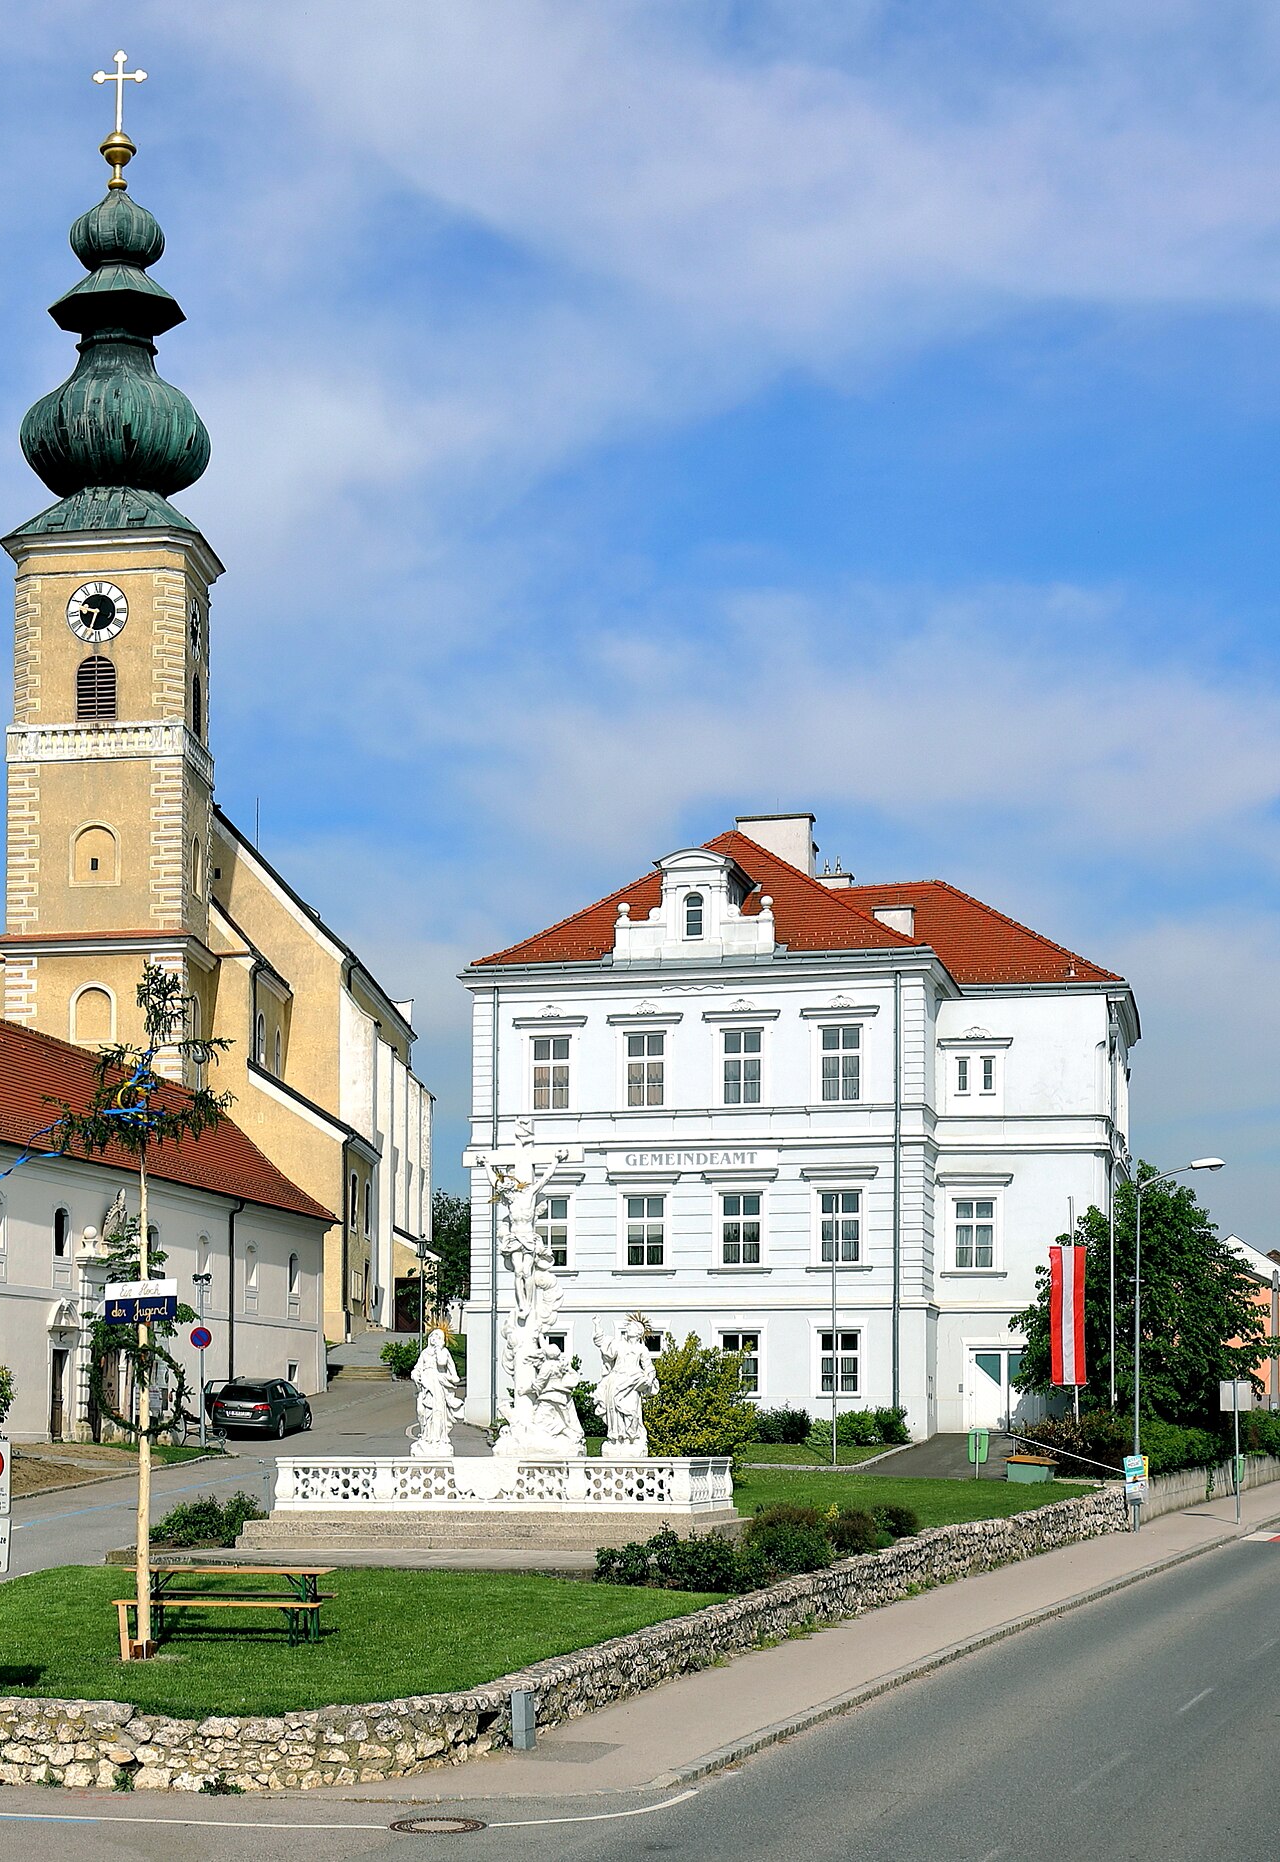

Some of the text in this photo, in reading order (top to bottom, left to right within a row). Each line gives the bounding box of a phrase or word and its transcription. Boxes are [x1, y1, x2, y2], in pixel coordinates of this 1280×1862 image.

[625, 1152, 758, 1166] GEMEINDEAMT
[138, 1283, 161, 1296] Hoch
[111, 1298, 168, 1322] der Jugend
